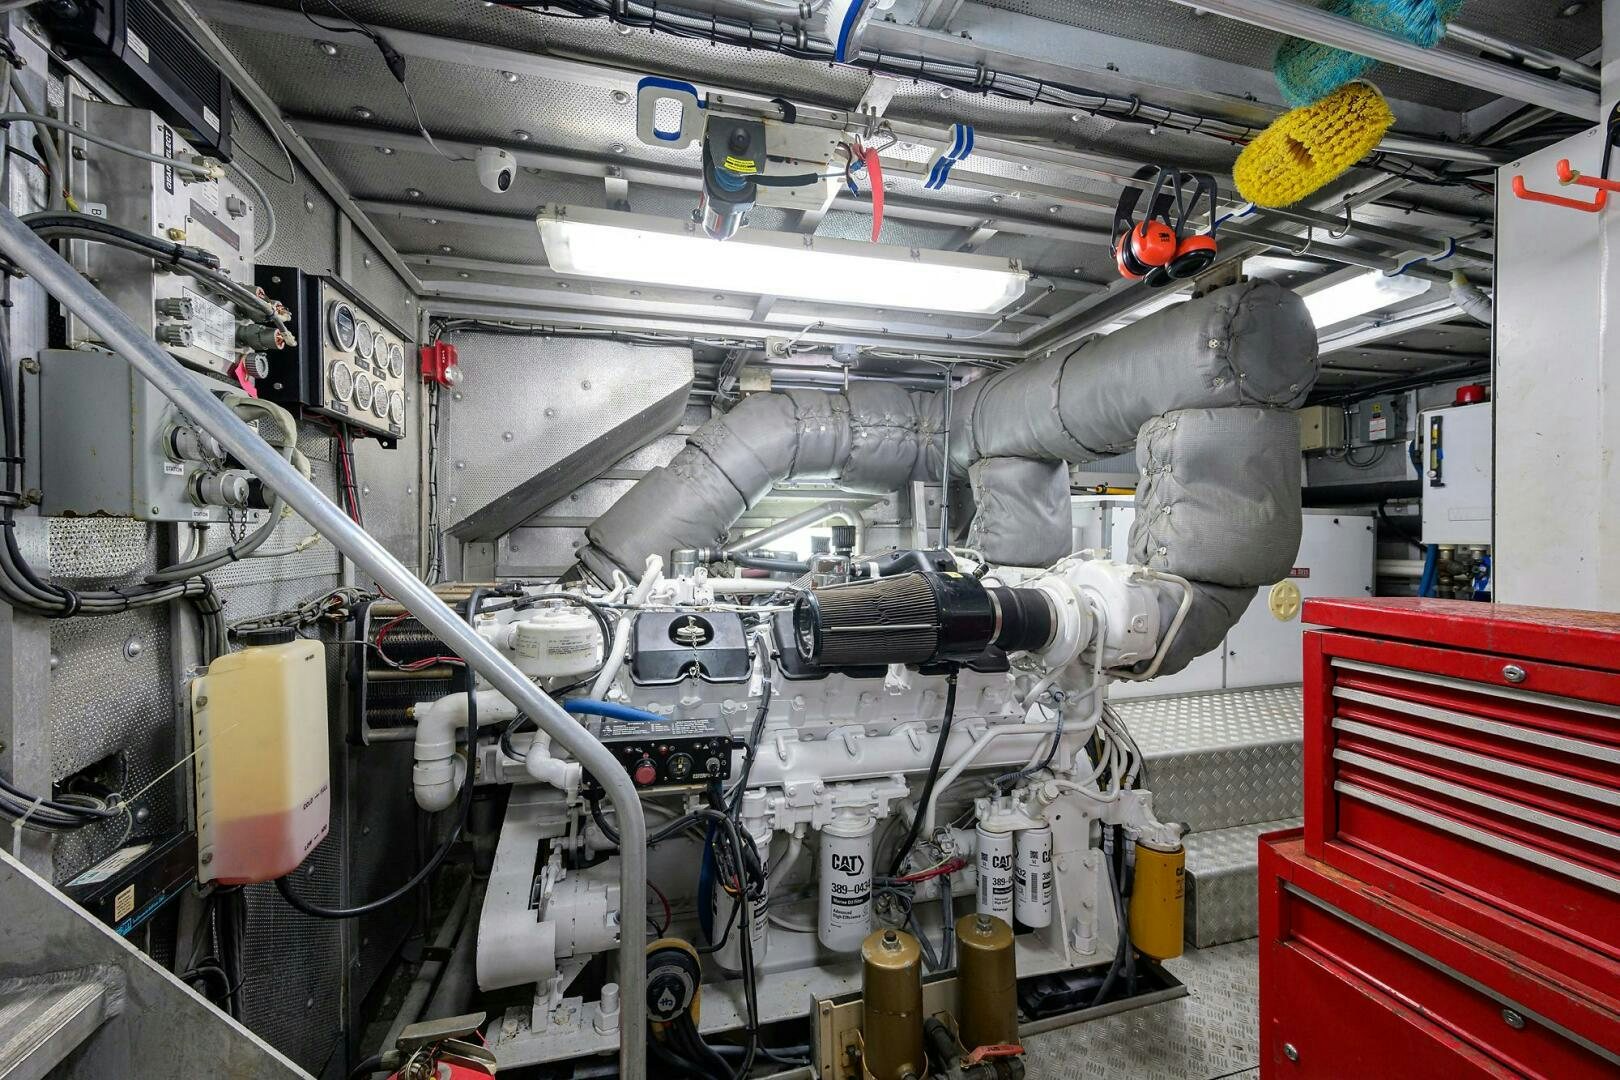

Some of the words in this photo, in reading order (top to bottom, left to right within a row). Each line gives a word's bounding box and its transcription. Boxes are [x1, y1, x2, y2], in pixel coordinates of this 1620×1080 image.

[165, 166, 173, 189] GEAR
[832, 853, 858, 872] CAT
[992, 854, 1012, 869] CAT
